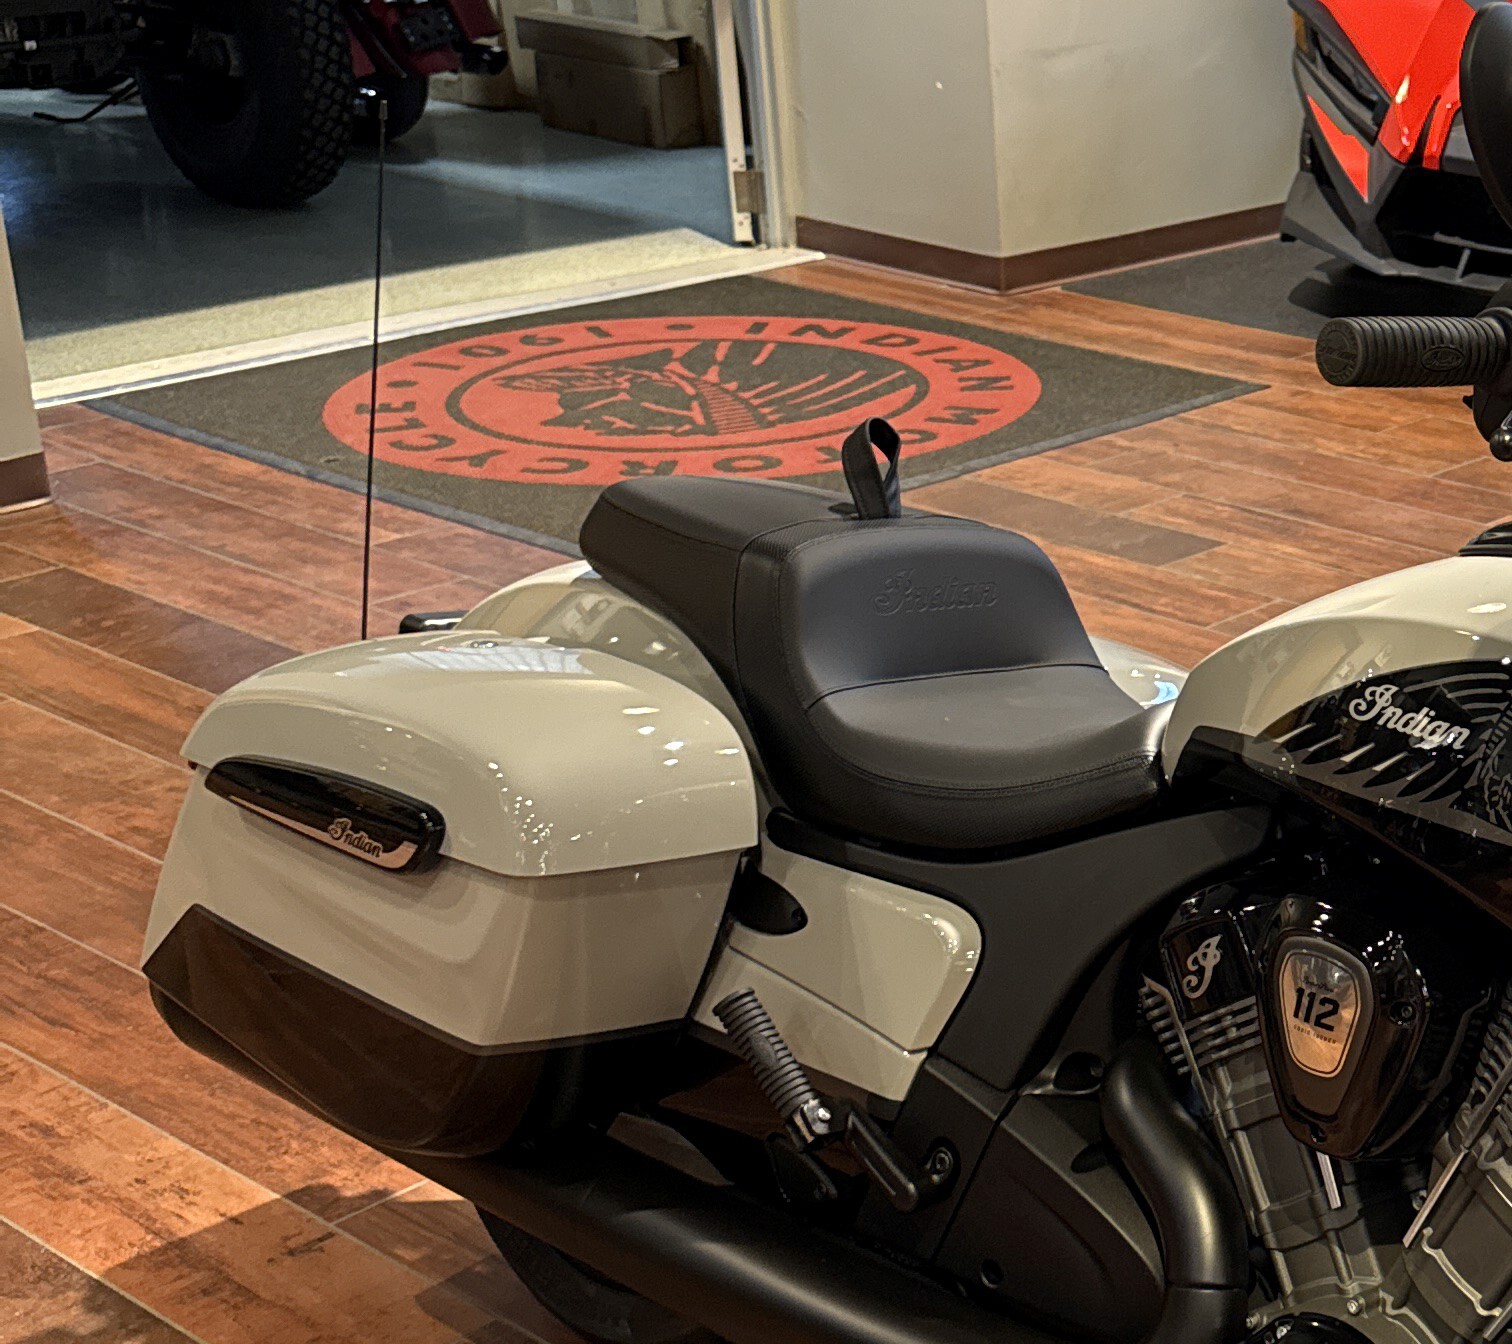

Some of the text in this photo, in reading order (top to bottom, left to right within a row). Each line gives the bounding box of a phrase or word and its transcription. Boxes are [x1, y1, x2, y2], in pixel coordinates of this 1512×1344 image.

[745, 321, 1015, 392] INDIAN
[1348, 684, 1471, 750] Indian
[327, 818, 382, 858] Indian
[1293, 987, 1340, 1032] 112
